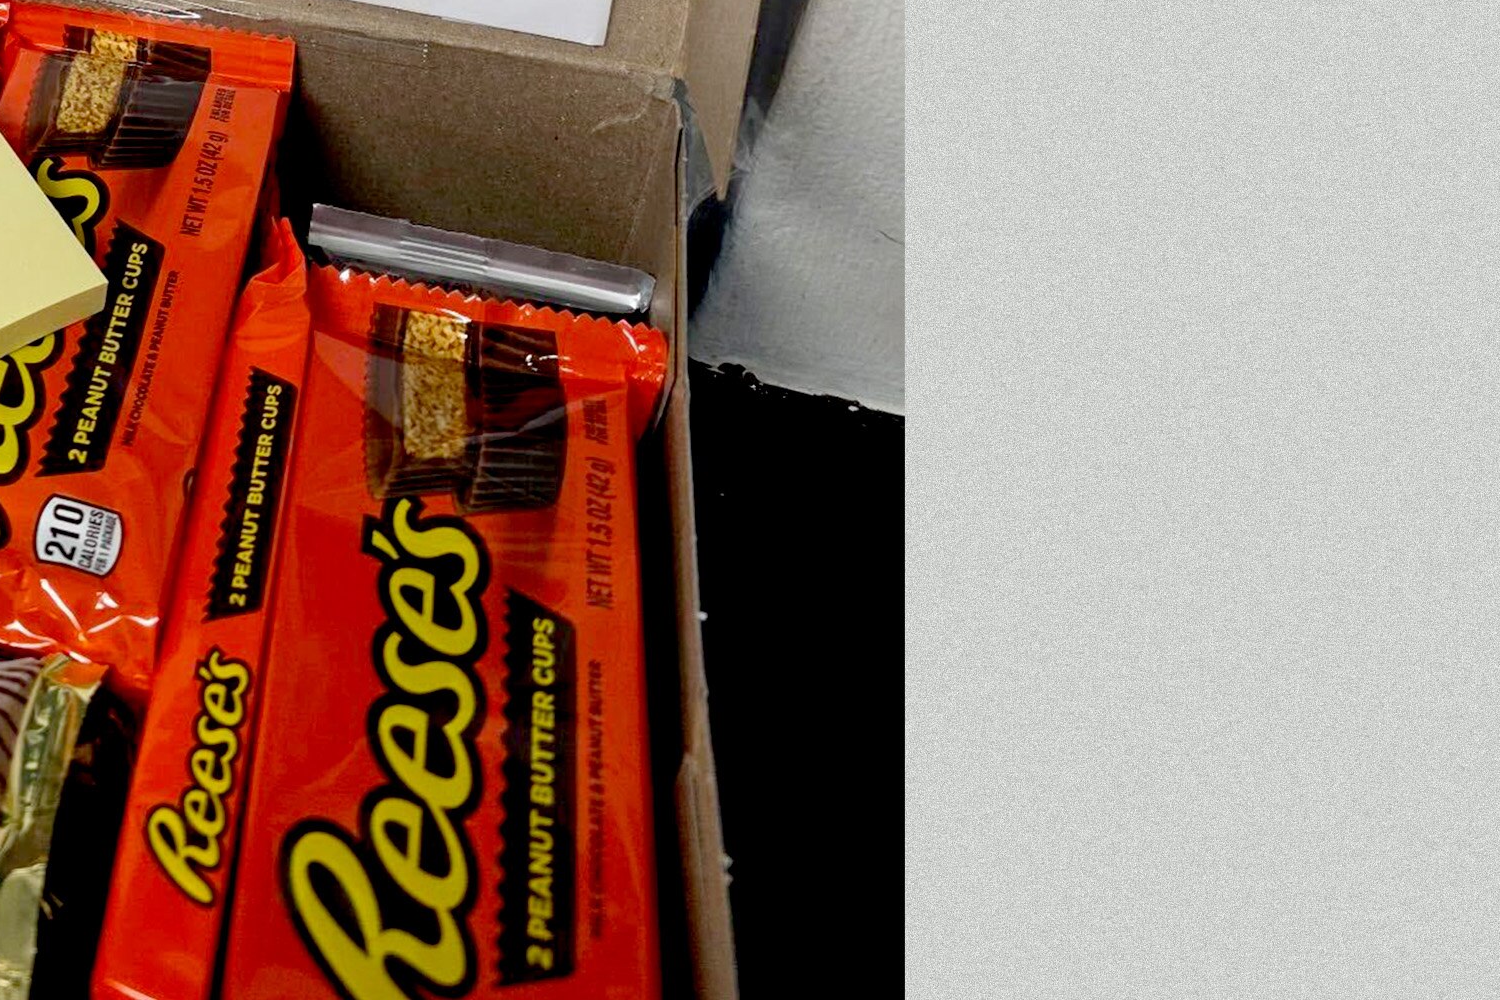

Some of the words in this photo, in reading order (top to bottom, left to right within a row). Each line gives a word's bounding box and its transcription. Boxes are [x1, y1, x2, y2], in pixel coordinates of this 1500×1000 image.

[199, 142, 224, 161] (42
[208, 130, 229, 144] g)
[192, 176, 214, 195] 1.5
[195, 159, 218, 177] OZ
[186, 194, 208, 214] WT
[179, 213, 204, 236] NET
[121, 242, 148, 290] CUPS
[98, 293, 135, 366] BUTTER
[149, 308, 170, 352] PEANUT
[160, 270, 180, 309] BUTTER
[73, 366, 111, 446] PEANUT
[261, 384, 283, 430] CUPS
[68, 448, 88, 464] 2
[246, 433, 274, 505] BUTTER
[586, 497, 612, 522] OZ
[44, 504, 84, 561] 210
[78, 510, 105, 568] CALORIES
[231, 508, 261, 590] PEANUT
[586, 522, 612, 547] 1.5
[228, 592, 246, 608] 2
[586, 577, 613, 610] NET
[531, 616, 556, 687] CUPS
[530, 690, 556, 807] BUTTER
[527, 808, 554, 942] PEANUT
[526, 945, 554, 972] 2
